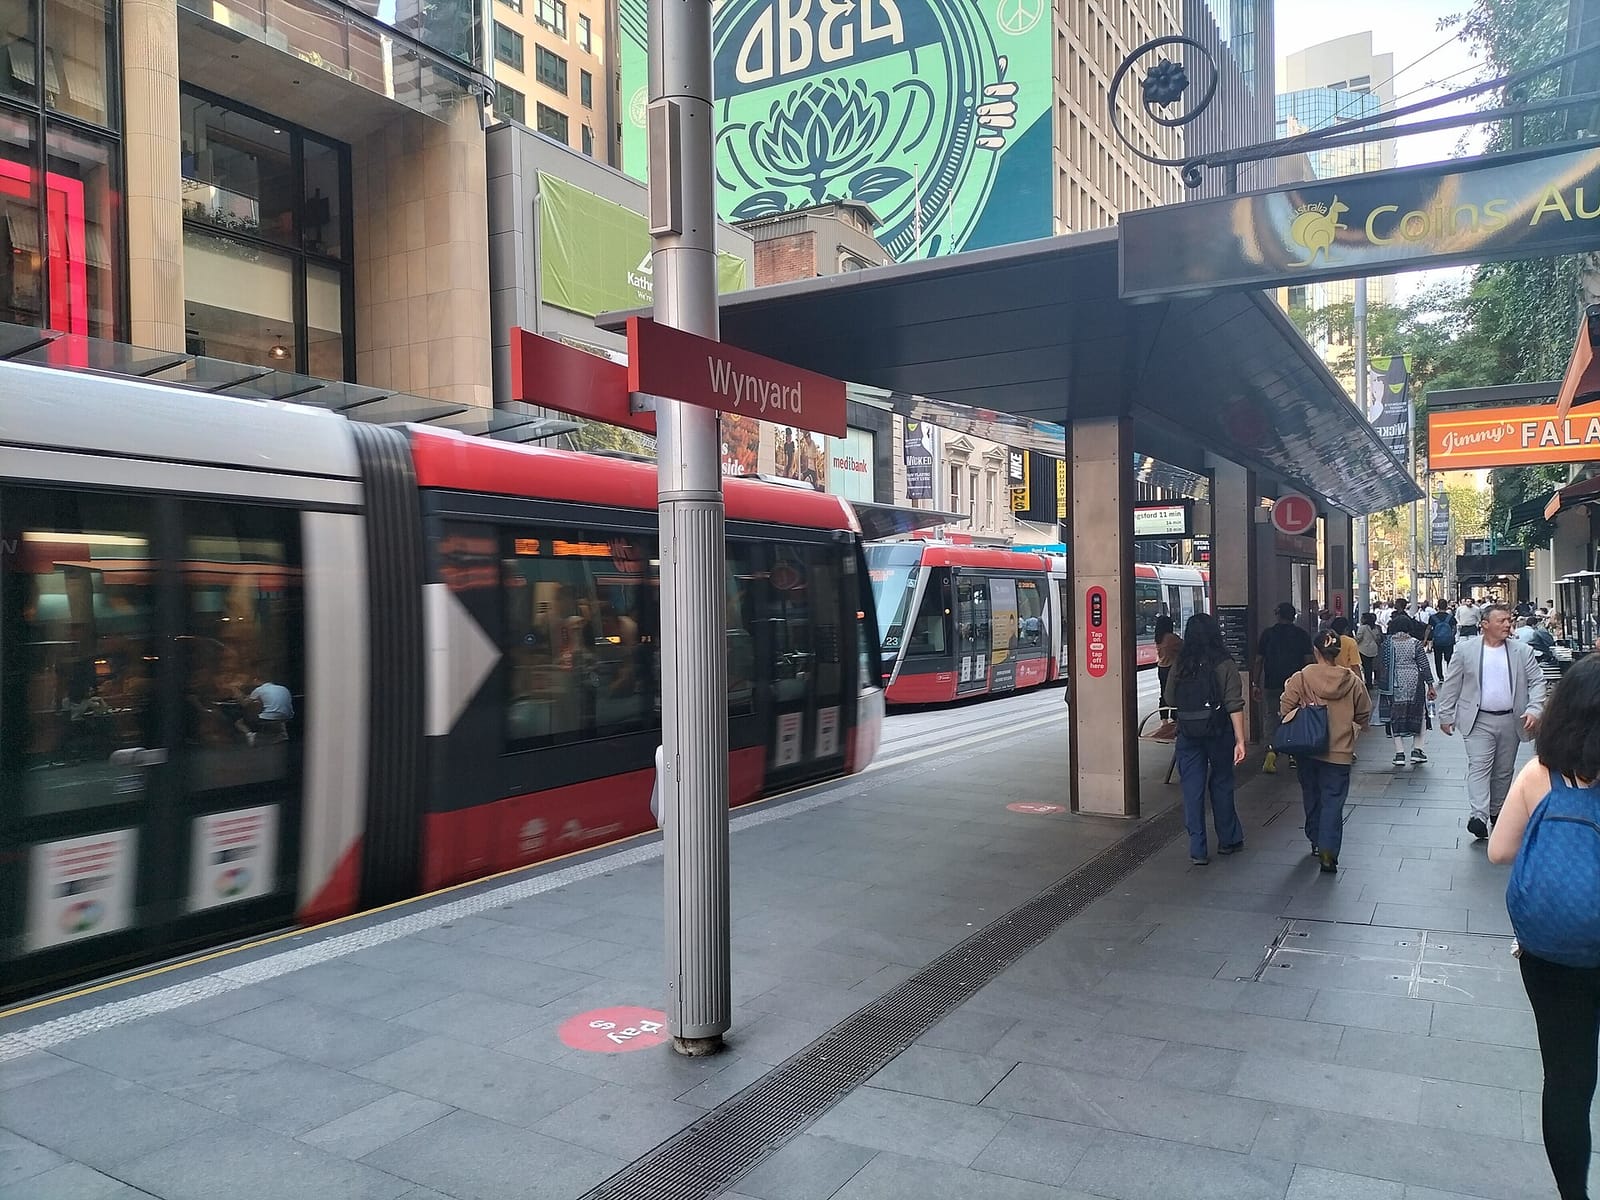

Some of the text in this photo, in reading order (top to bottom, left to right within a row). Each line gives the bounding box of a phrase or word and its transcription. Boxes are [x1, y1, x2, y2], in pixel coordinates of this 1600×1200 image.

[1365, 199, 1508, 246] Coins
[708, 355, 802, 414] Wynyard
[1441, 416, 1600, 456] Jimmy's FALA
[833, 455, 868, 473] medibank
[1010, 452, 1023, 480] NIKE
[1286, 502, 1302, 525] L
[886, 636, 899, 646] 23
